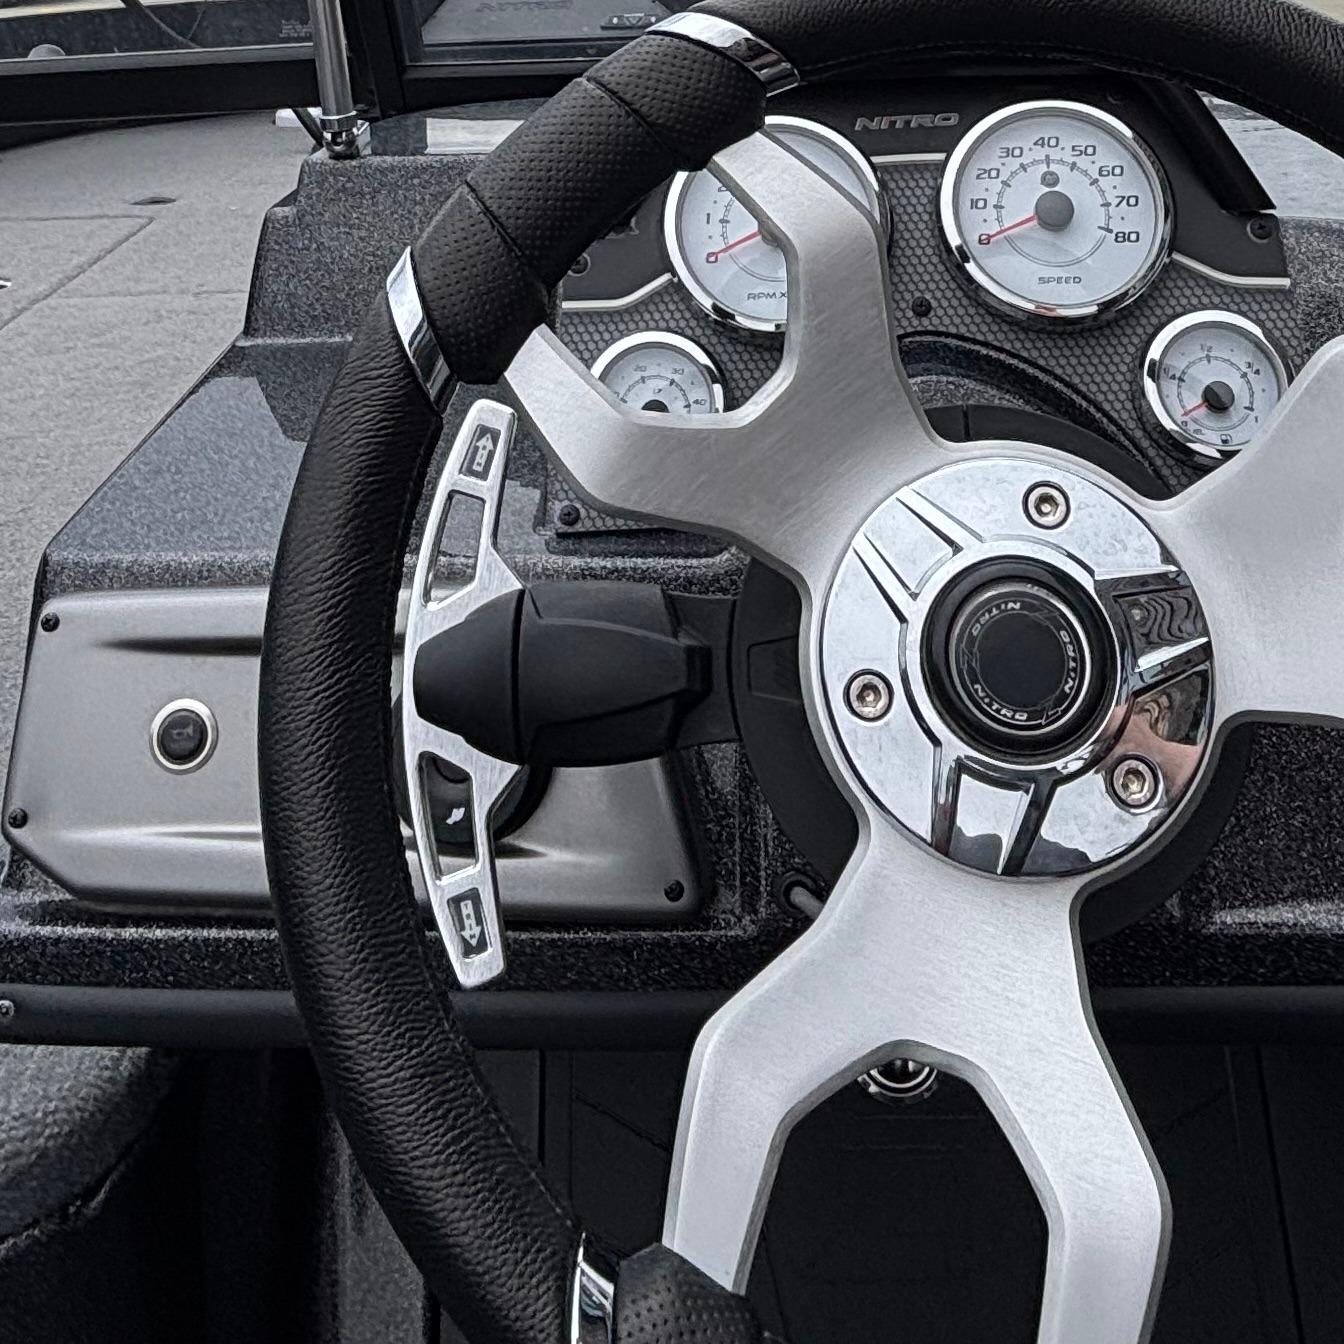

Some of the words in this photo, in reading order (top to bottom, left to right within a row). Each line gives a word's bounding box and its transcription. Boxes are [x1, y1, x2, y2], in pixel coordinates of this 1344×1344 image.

[854, 112, 960, 131] NITRO
[1033, 136, 1059, 148] 40
[998, 146, 1023, 158] 30
[1071, 145, 1097, 157] 50
[976, 168, 1000, 180] 20
[1098, 165, 1124, 177] 60
[970, 198, 987, 210] 10
[1115, 195, 1139, 208] 70
[978, 233, 991, 245] 0
[1114, 231, 1140, 243] 80
[706, 252, 718, 263] 0
[1038, 276, 1082, 284] SPEED
[747, 292, 777, 301] RPM
[972, 601, 1021, 636] NITRO
[1059, 630, 1077, 694] NITRO
[974, 683, 1029, 721] NITRO
